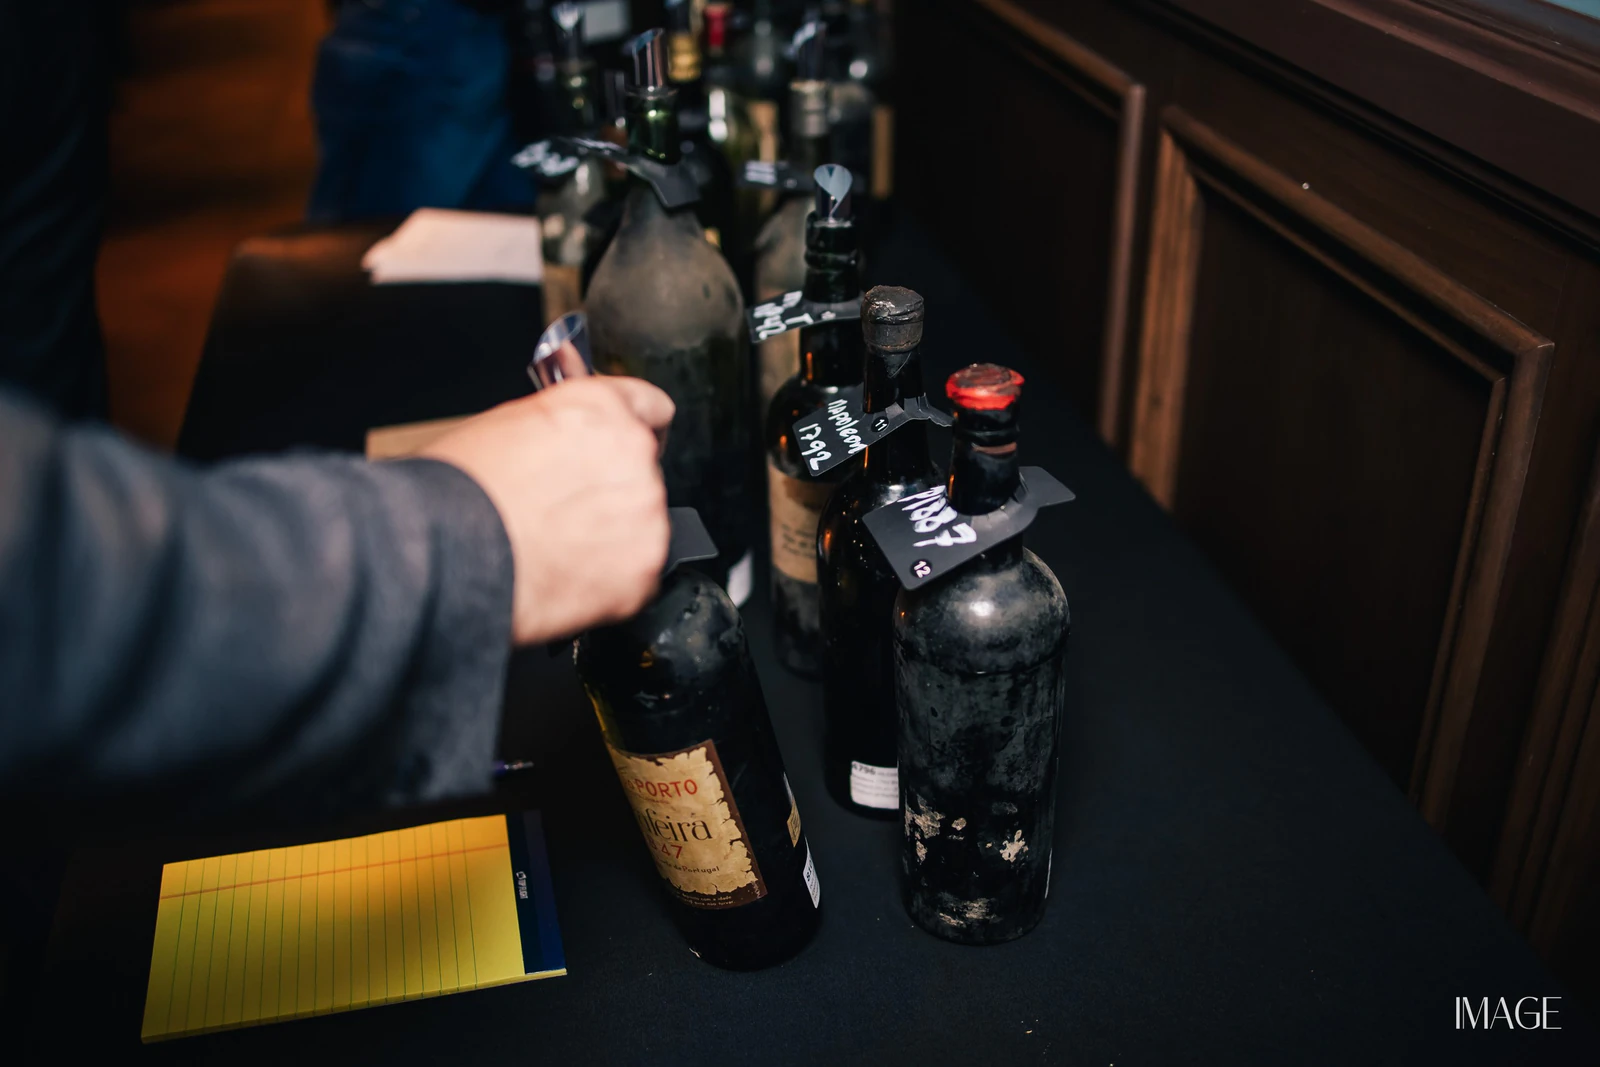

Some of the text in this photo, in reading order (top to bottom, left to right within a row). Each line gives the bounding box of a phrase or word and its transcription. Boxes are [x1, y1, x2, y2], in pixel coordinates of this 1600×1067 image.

[874, 418, 889, 432] 11
[799, 423, 832, 471] 1792
[913, 560, 932, 579] 12
[634, 778, 698, 798] PORTO
[638, 807, 713, 842] feira
[682, 865, 720, 875] Portugal
